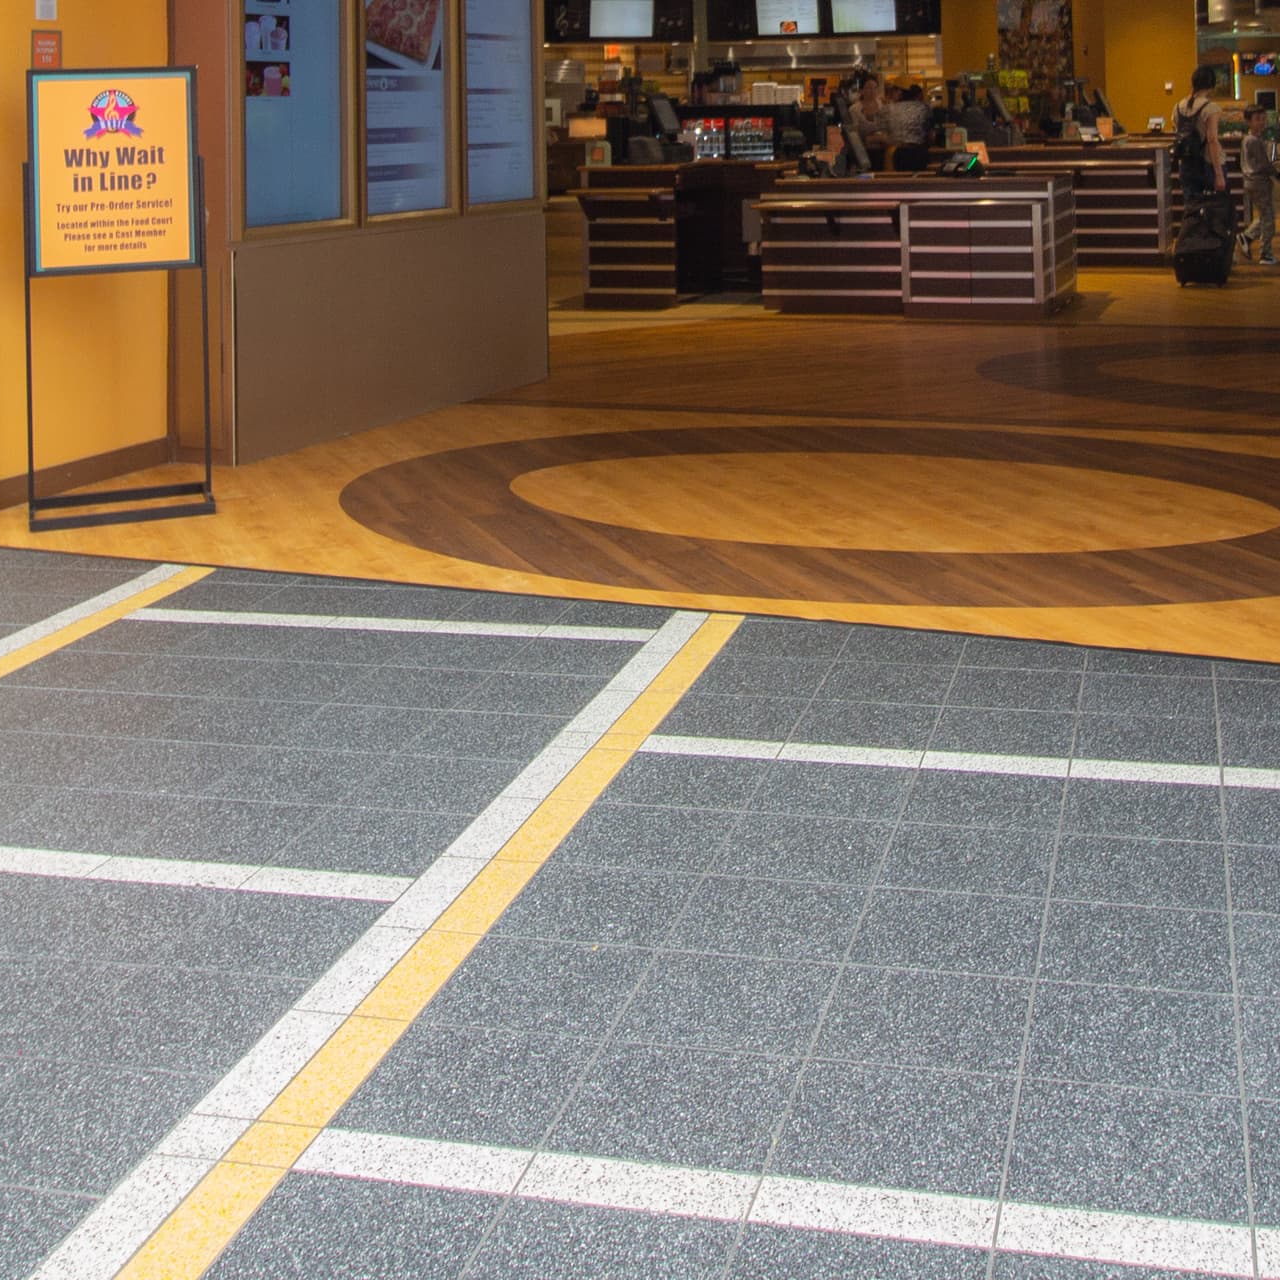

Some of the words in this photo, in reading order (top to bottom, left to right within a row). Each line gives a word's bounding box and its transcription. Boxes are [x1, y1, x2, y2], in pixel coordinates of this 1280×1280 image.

[64, 148, 110, 168] Why
[116, 146, 165, 165] Wait
[73, 174, 93, 192] in
[56, 204, 71, 214] Try
[73, 204, 88, 212] our
[90, 200, 133, 211] Pre-Order
[136, 198, 173, 209] Service!
[57, 221, 88, 230] Located
[90, 219, 115, 228] within
[116, 218, 129, 227] the
[131, 217, 149, 226] Food
[151, 216, 173, 225] Court
[64, 233, 91, 241] Please
[93, 232, 107, 240] see
[115, 230, 133, 239] Cast
[135, 229, 166, 238] Member
[84, 243, 95, 252] for
[97, 243, 118, 251] more
[120, 241, 147, 250] details
